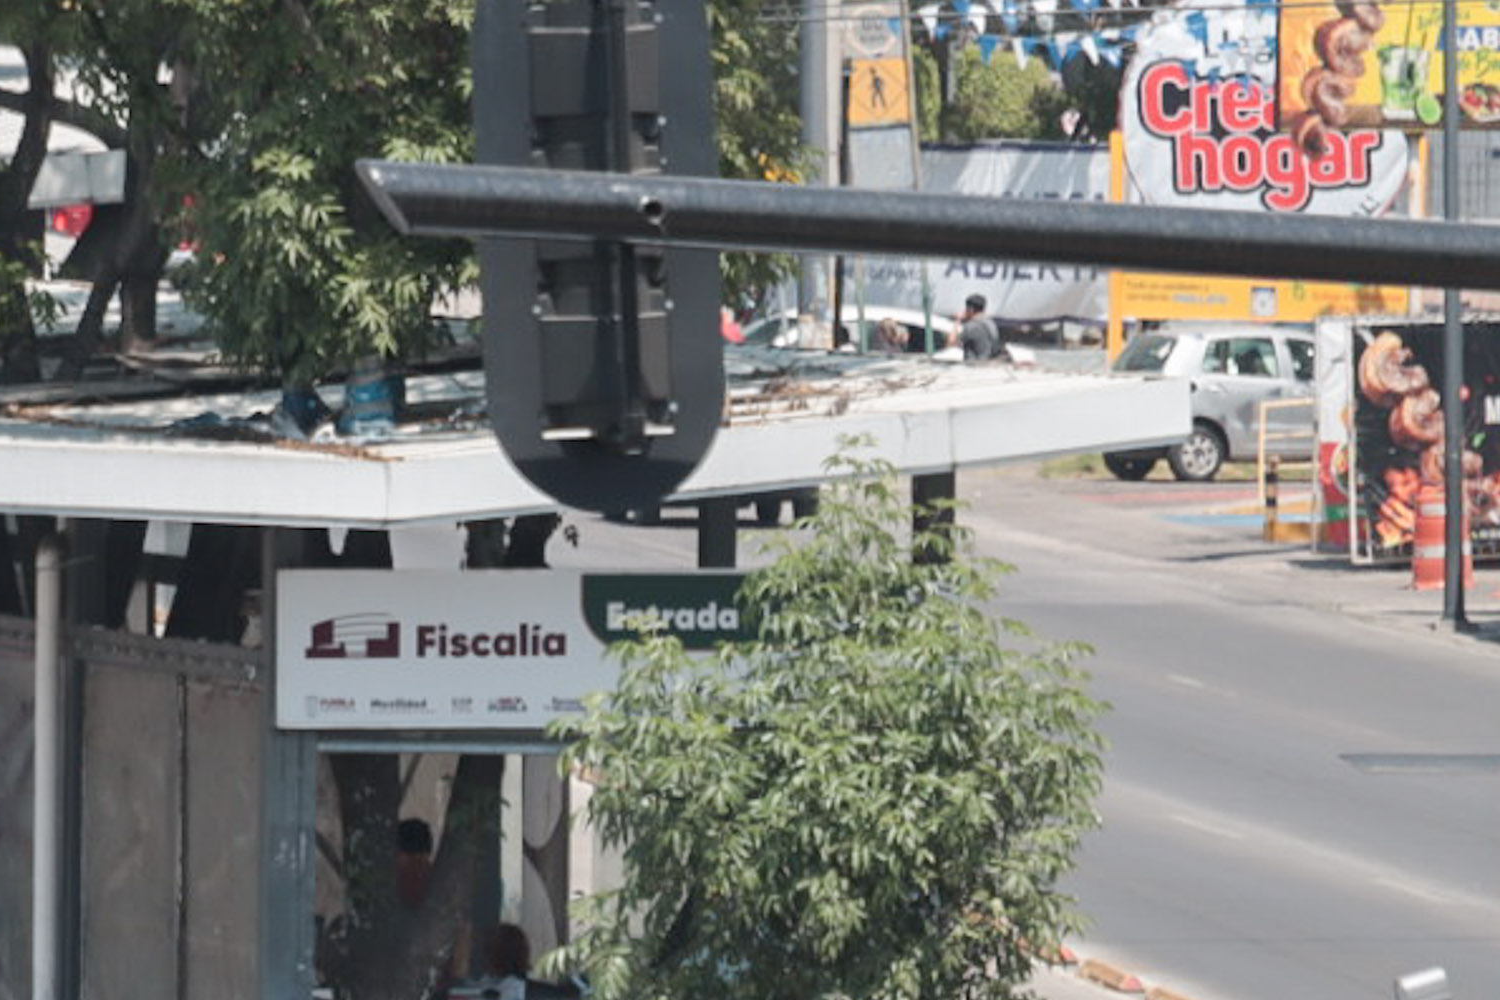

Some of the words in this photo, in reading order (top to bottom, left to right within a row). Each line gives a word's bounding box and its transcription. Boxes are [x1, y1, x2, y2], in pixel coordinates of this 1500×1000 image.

[1175, 129, 1383, 214] hogar
[605, 600, 740, 632] Entrada
[415, 622, 567, 658] Fiscalía
